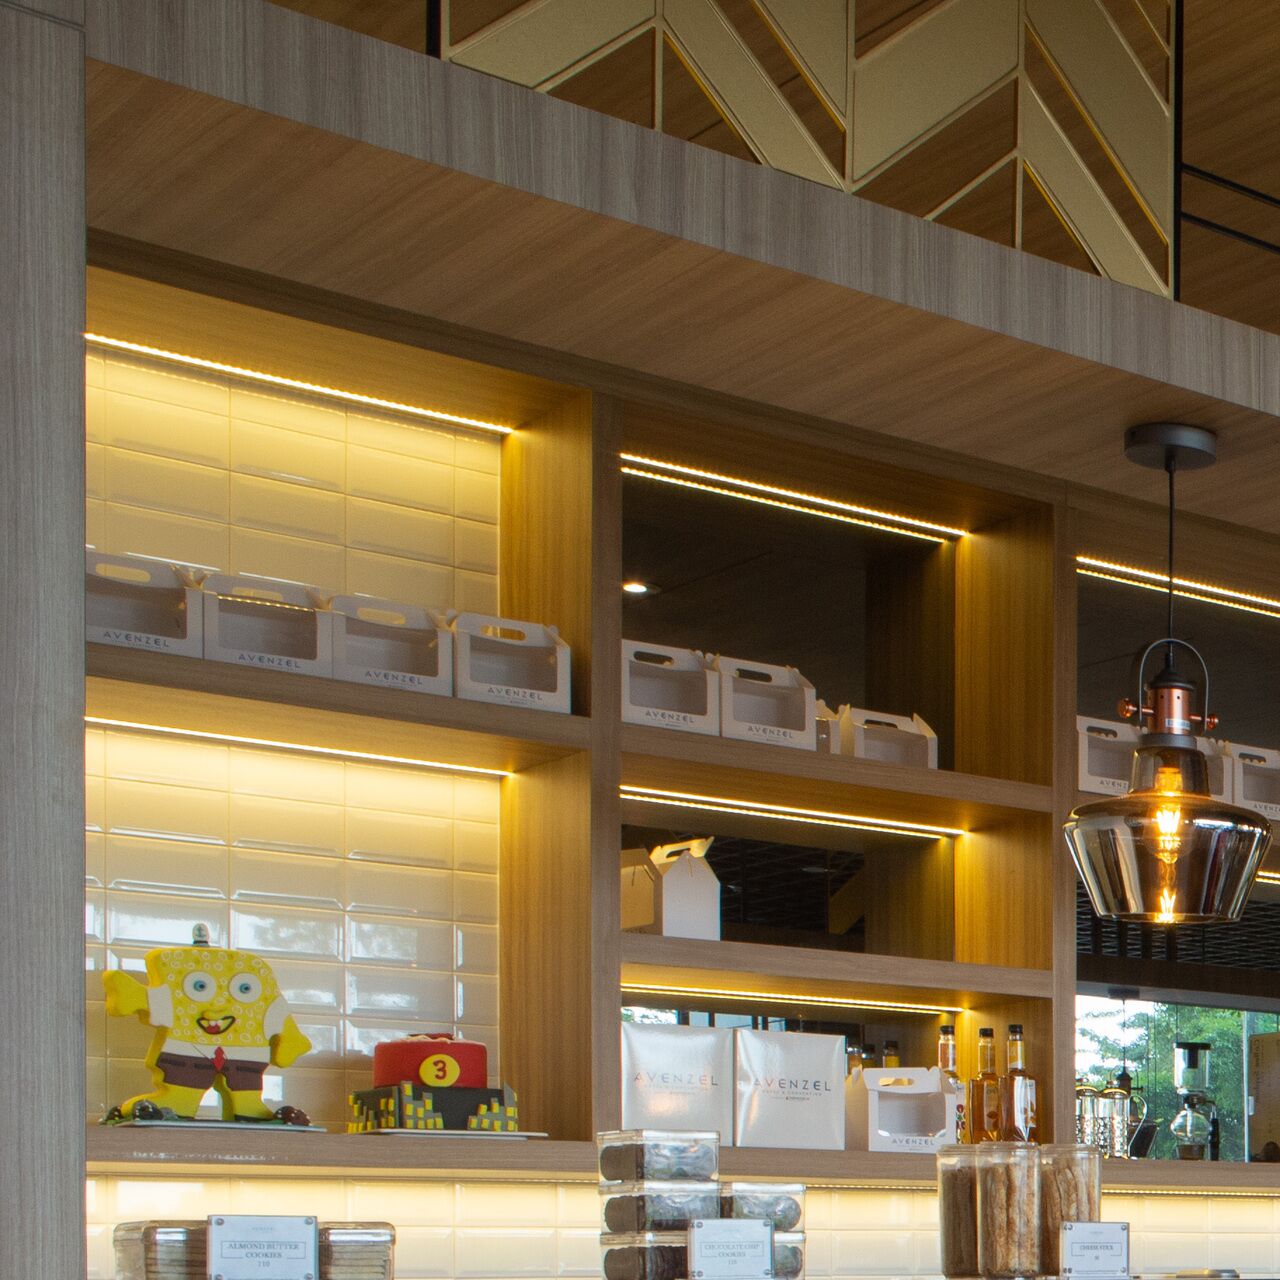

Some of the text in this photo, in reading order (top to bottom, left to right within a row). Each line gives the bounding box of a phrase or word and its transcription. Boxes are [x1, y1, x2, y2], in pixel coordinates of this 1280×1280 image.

[103, 631, 171, 648] AVENZEL
[238, 653, 301, 668] AVENZEL
[364, 670, 423, 685] AVENZEL
[487, 686, 543, 700] AVENZEL
[645, 710, 695, 723] AVENZEL
[747, 726, 793, 738] AVENZEL
[433, 1059, 447, 1080] 3
[634, 1072, 719, 1086] AVENZEL
[753, 1077, 832, 1092] AVENZEL
[891, 1138, 935, 1146] AVENZEL
[245, 1251, 282, 1259] COOKIES
